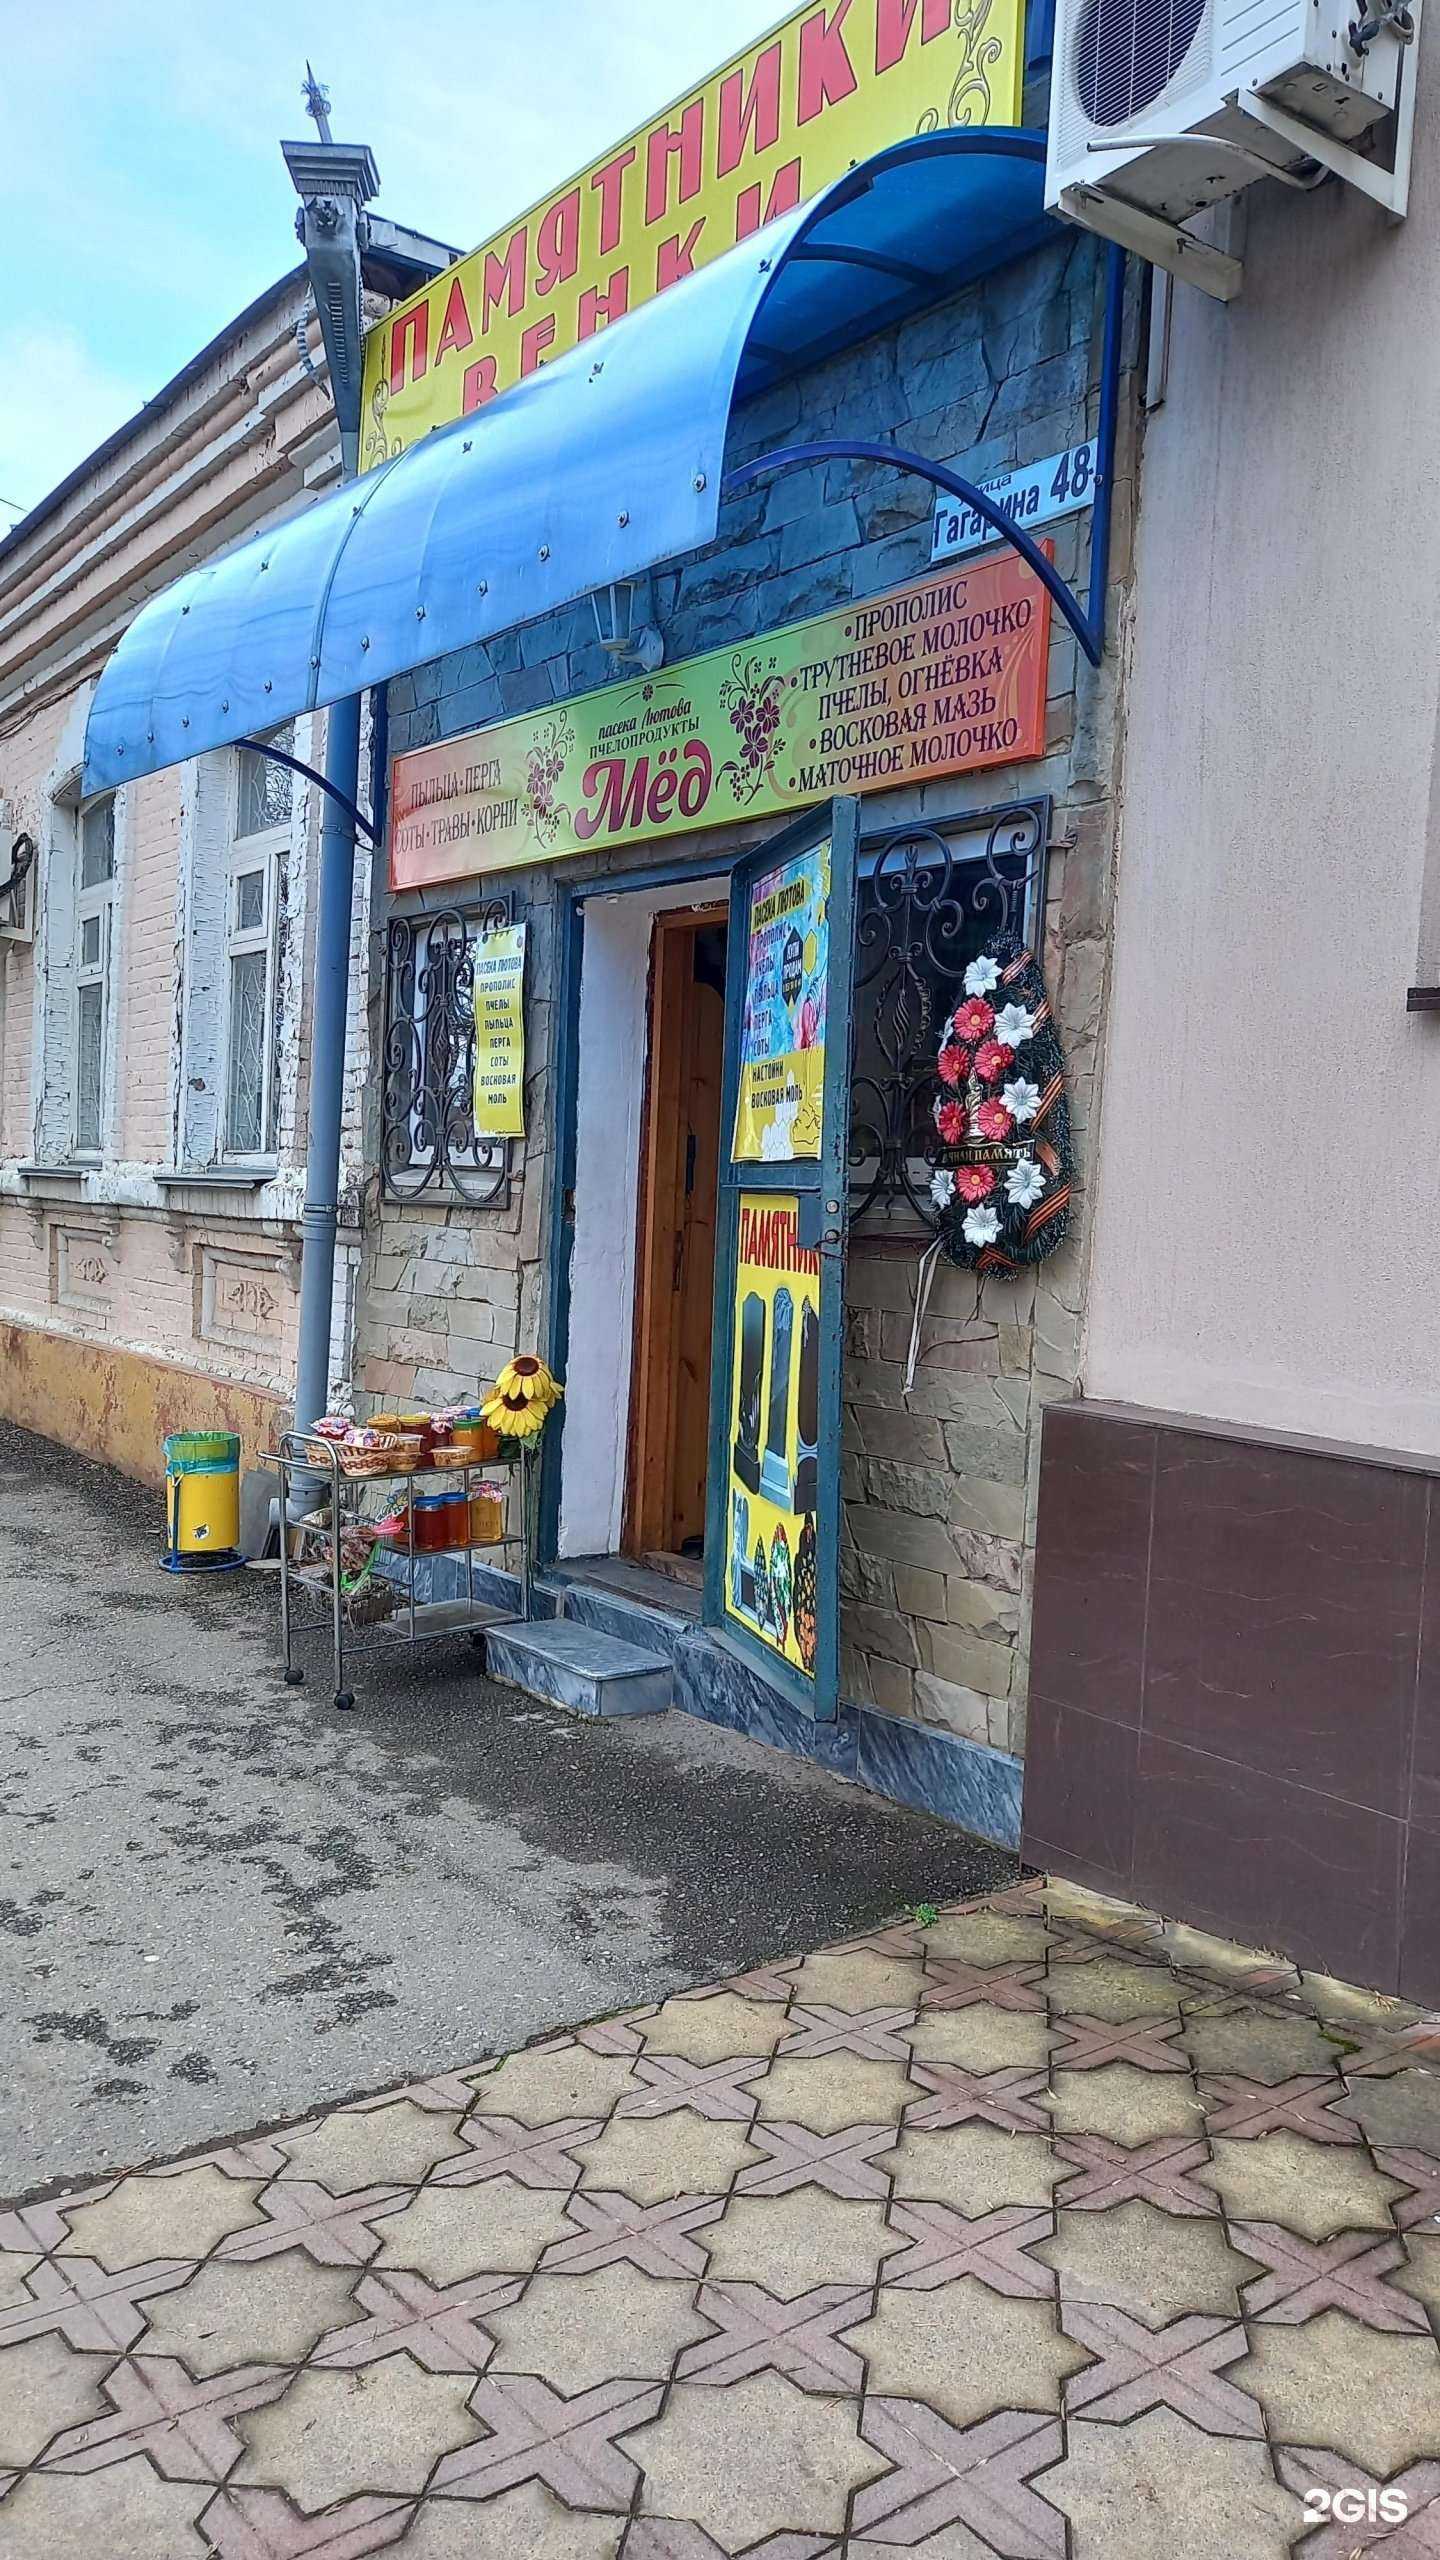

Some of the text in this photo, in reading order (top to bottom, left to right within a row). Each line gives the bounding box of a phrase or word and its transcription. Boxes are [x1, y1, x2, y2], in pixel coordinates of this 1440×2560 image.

[1050, 445, 1091, 503] 48
[853, 580, 968, 642] ПРОПОЛИС
[799, 598, 1031, 691] ТРУТНЕВОЕ МОЛОЧКО
[817, 646, 1003, 721] ПЧЕЛЫ, ОГНЁВКА
[589, 716, 700, 760] ПЧЕЛОПРОДУКТЫ
[598, 698, 692, 740] пасека Лютова
[819, 687, 997, 754] ВОСКОВАЯ МАЗЬ
[798, 717, 1018, 793] МАТОЧНОЕ МОЛОЧКО
[410, 759, 502, 809] ПЫЛЬЦА ПЕРГА
[574, 739, 712, 840] Мёд
[394, 798, 519, 854] СОТЫ ТРАВЫ КОРНИ
[480, 978, 516, 993] ПРОПОЛИС
[485, 998, 510, 1011] ПЧЕЛЫ
[484, 1017, 514, 1031] ПЫЛЬЦА
[489, 1036, 511, 1049] ПЕРГА
[490, 1055, 510, 1067] СОТЫ
[753, 1037, 770, 1056] СОТЫ
[480, 1073, 517, 1086] ВОСКОВАЯ
[487, 1093, 508, 1105] МОЛЬ
[786, 1083, 803, 1103] МОЛЬ
